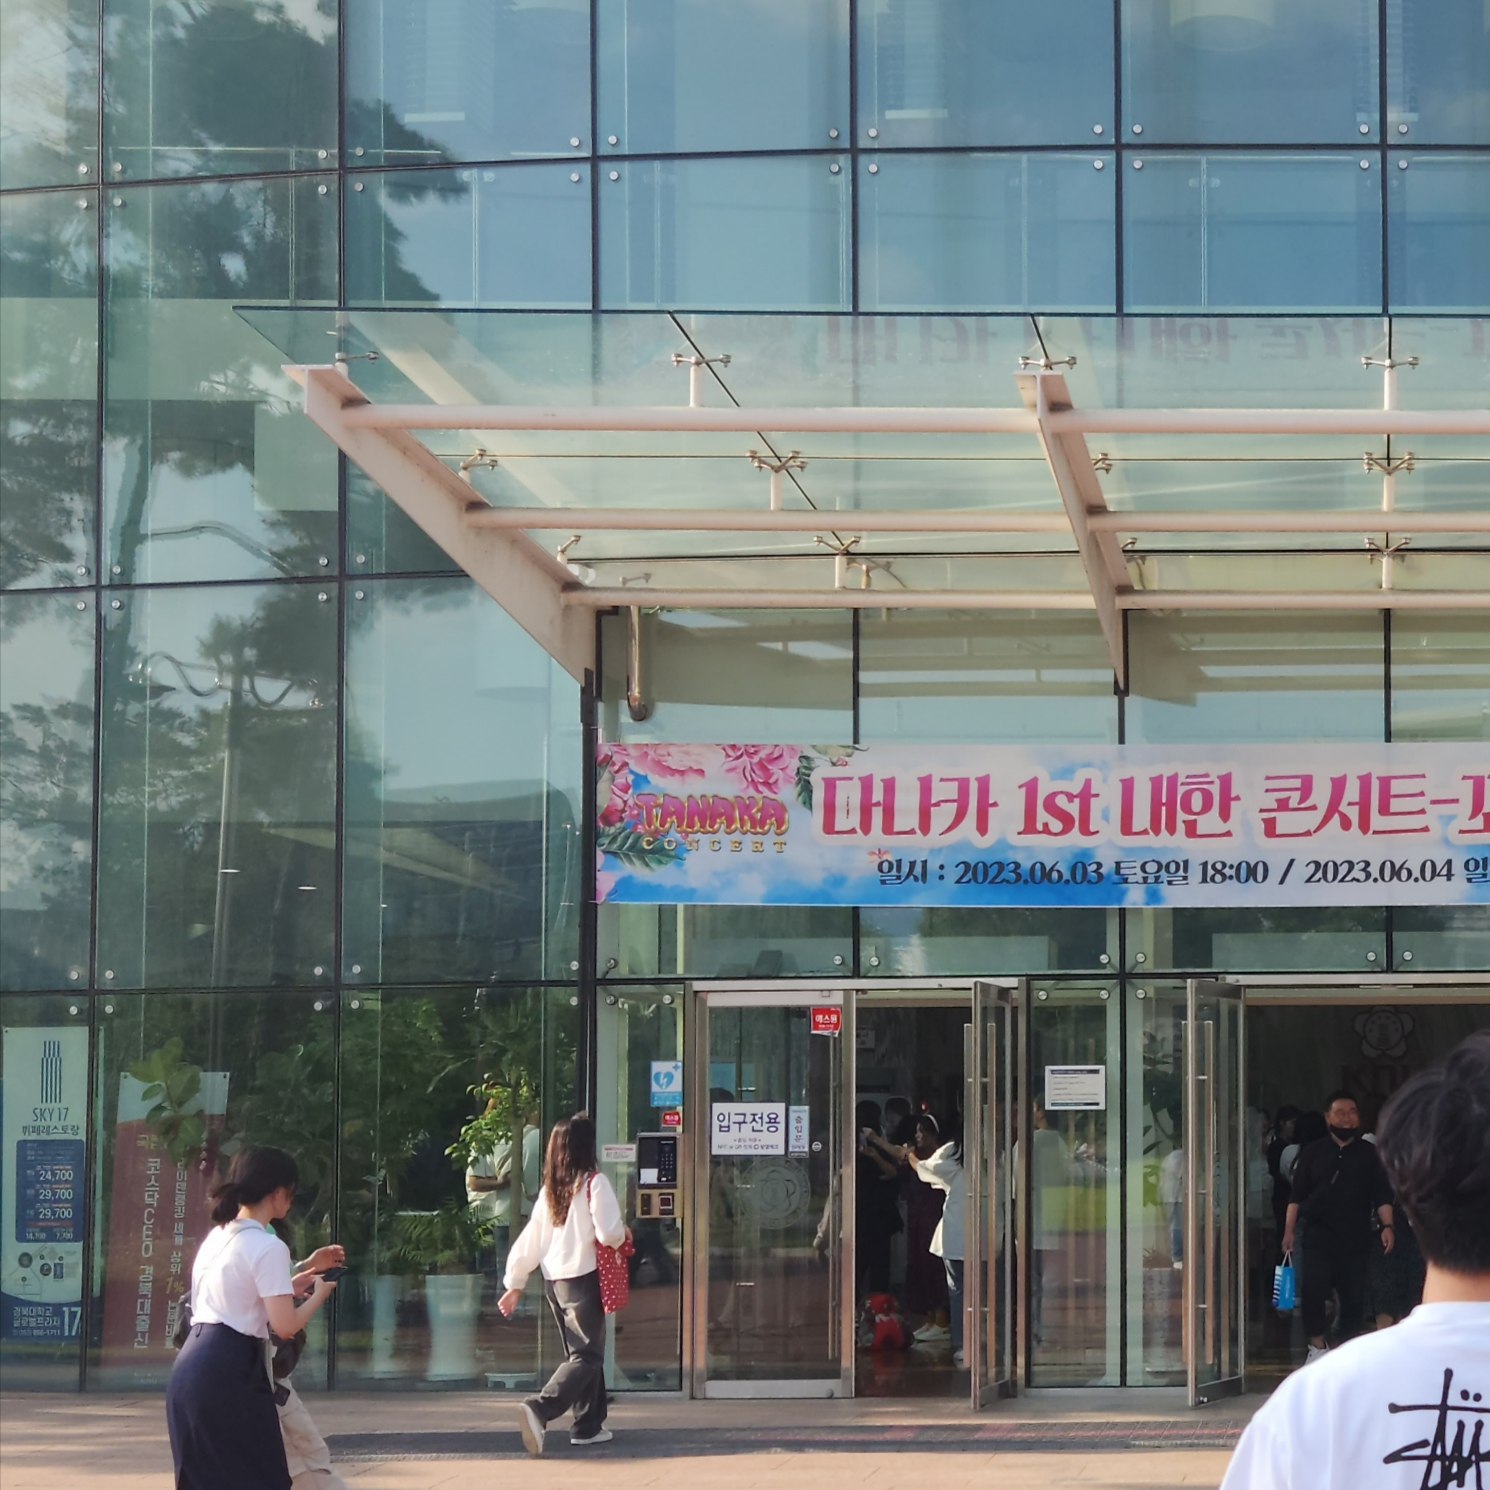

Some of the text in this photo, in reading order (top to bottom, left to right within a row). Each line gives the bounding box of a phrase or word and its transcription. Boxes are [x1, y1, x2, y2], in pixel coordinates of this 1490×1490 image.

[819, 771, 1000, 838] 다나카
[1017, 772, 1099, 837] 1st
[1118, 771, 1240, 839] 내한
[634, 792, 789, 836] TANAKA
[641, 836, 787, 853] CONCERT
[878, 858, 929, 886] 일시
[954, 860, 1105, 886] 2023.06.03
[1113, 858, 1189, 886] 토요일
[1198, 859, 1269, 886] 18:00
[1304, 856, 1455, 885] 2023.06.04
[32, 1107, 69, 1122] SKY 17
[716, 1112, 781, 1133] 입구전용
[39, 1170, 74, 1181] 24,700
[38, 1189, 74, 1200] 29,700
[38, 1208, 73, 1219] 29,700
